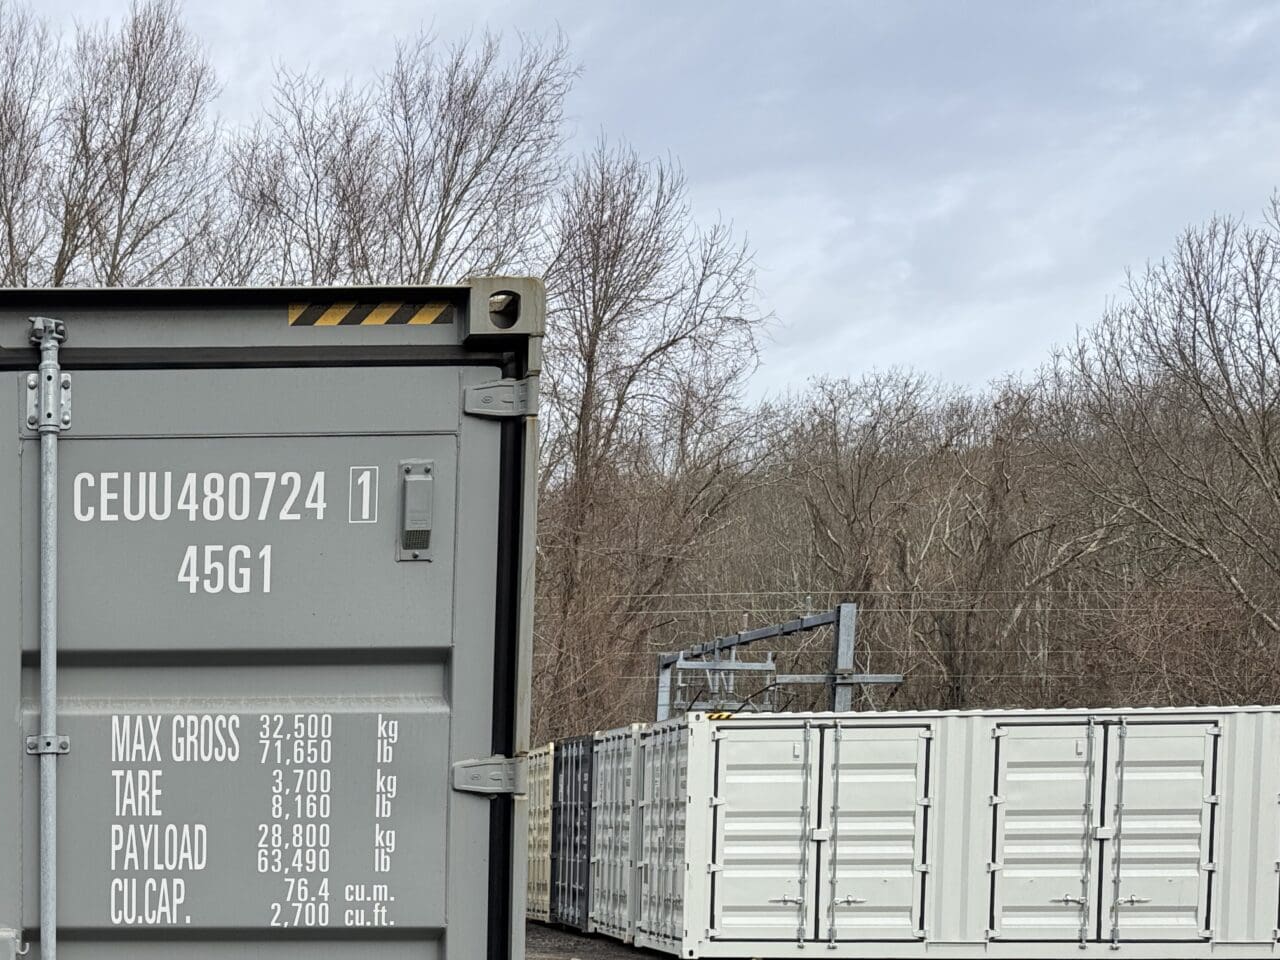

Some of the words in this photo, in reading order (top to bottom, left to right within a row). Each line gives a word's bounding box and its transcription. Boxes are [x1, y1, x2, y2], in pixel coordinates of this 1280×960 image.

[356, 471, 370, 519] 1
[178, 545, 271, 593] 45G1
[111, 714, 162, 762] MAX
[172, 714, 240, 762] GROSS
[259, 714, 332, 740] 32,500
[378, 714, 398, 743] kg
[258, 740, 331, 764] 71,650
[377, 739, 392, 763] lb
[112, 770, 162, 816] TARE
[272, 769, 331, 794] 3,700
[376, 769, 397, 798] kg
[272, 795, 330, 820] 8,160
[376, 794, 391, 818] lb
[111, 824, 207, 870] PAYLOAD
[258, 824, 330, 849] 28,800
[375, 823, 396, 852] kg
[257, 849, 330, 874] 63,490
[374, 849, 390, 872] lb
[110, 878, 191, 924] CU.CAP.
[284, 878, 330, 901] 76.4
[344, 884, 395, 901] cu.m.
[270, 903, 329, 927] 2,700
[344, 905, 395, 926] cu.ft.
